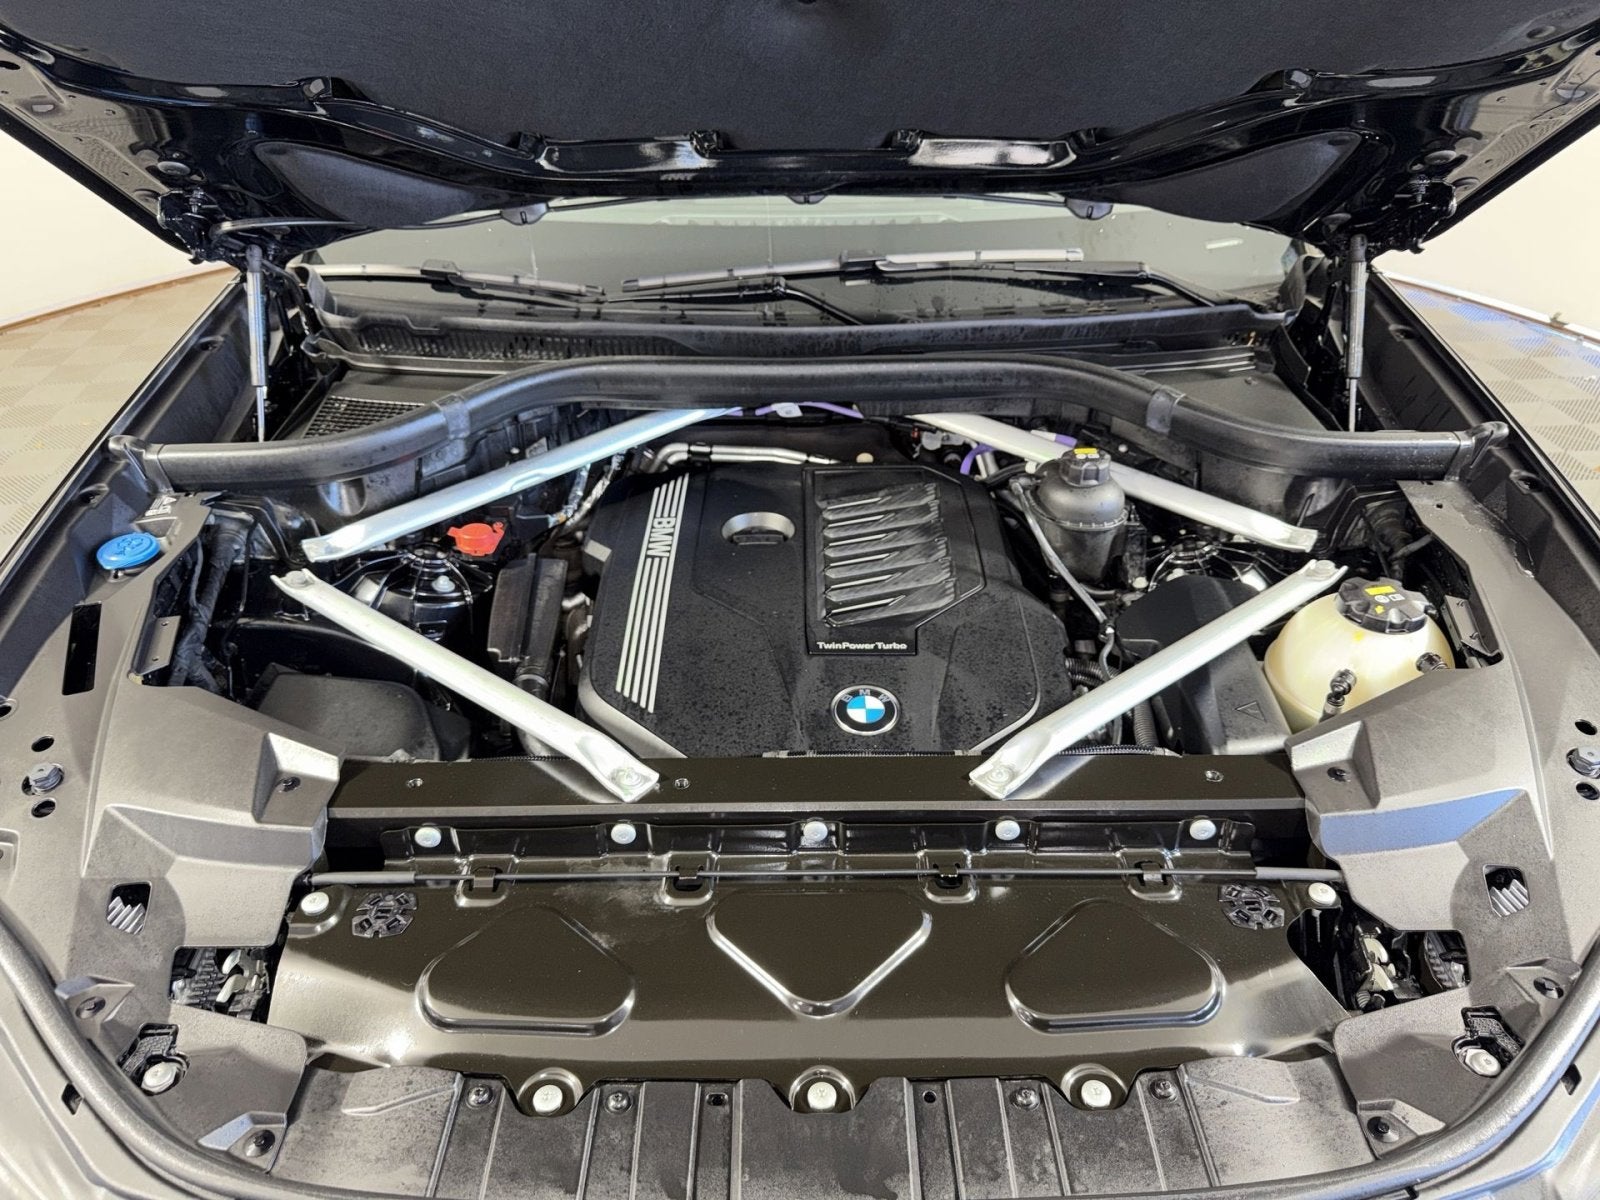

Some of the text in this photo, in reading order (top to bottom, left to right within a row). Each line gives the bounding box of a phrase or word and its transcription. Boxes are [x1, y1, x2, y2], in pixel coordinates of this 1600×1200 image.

[646, 517, 677, 557] BMW
[875, 641, 908, 650] Turbo
[840, 688, 891, 703] BMW
